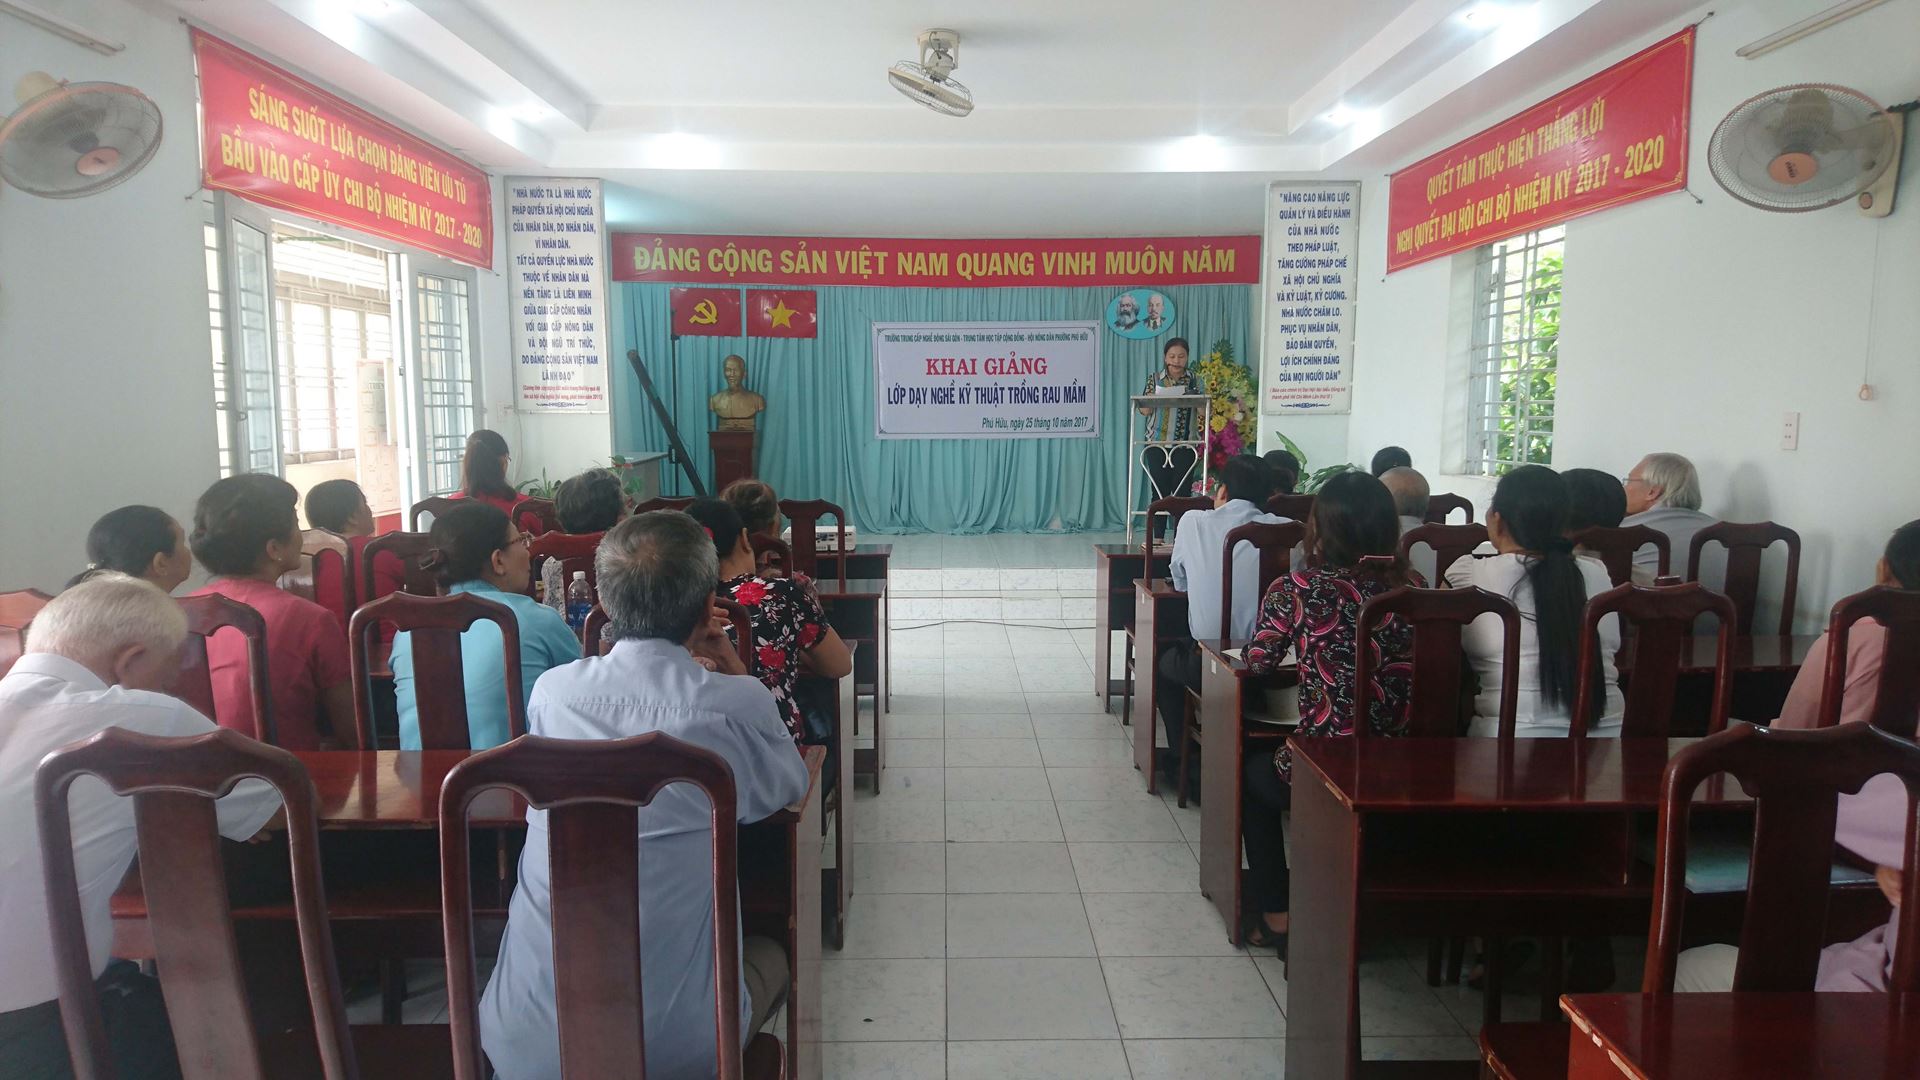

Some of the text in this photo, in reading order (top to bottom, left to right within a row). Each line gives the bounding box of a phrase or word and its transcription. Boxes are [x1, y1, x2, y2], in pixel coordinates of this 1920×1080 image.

[249, 84, 466, 204] SÁNG SUỐT LỰA CHỌN ĐẢNG VIÊN ƯU TÚ
[1427, 96, 1605, 204] QUYẾT TÂM THỰC HIỆN THẮNG LỢI
[221, 125, 254, 173] BẦU
[259, 145, 289, 185] VÀO
[293, 153, 320, 193] CẤP
[323, 160, 340, 200] ỦY
[344, 177, 363, 208] CHI
[367, 183, 382, 219] BỘ
[384, 193, 416, 228] NHIỆM
[419, 202, 431, 230] KỲ
[434, 211, 455, 239] 2017
[463, 224, 482, 249] 2020
[546, 190, 553, 198] TA
[1303, 194, 1316, 202] CAO
[1397, 226, 1412, 254] NGHỊ
[1415, 209, 1440, 251] QUYẾT
[1441, 218, 1454, 241] ĐẠI
[1458, 199, 1474, 236] HỘI
[1477, 203, 1492, 228] CHI
[1495, 185, 1510, 224] BỘ
[1513, 172, 1551, 216] NHIỆM
[1554, 162, 1571, 201] KỲ
[1575, 154, 1610, 194] 2017
[1624, 135, 1664, 179] 2020
[557, 223, 564, 232] DO
[634, 239, 1236, 280] ĐẢNG CỘNG SẢN VIỆT NAM QUANG VINH MUÔN NĂM
[1288, 243, 1303, 252] THEO
[926, 351, 1048, 375] KHAI GIẢNG
[888, 378, 1086, 408] LỚP DẠY NGHỀ KỸ THUẬT TRỒNG RAU MẦM
[982, 418, 994, 428] Phú
[1025, 418, 1032, 427] 25
[1034, 417, 1050, 430] tháng
[1052, 417, 1059, 427] 10
[1060, 418, 1073, 427] năm
[1074, 417, 1088, 427] 2017
